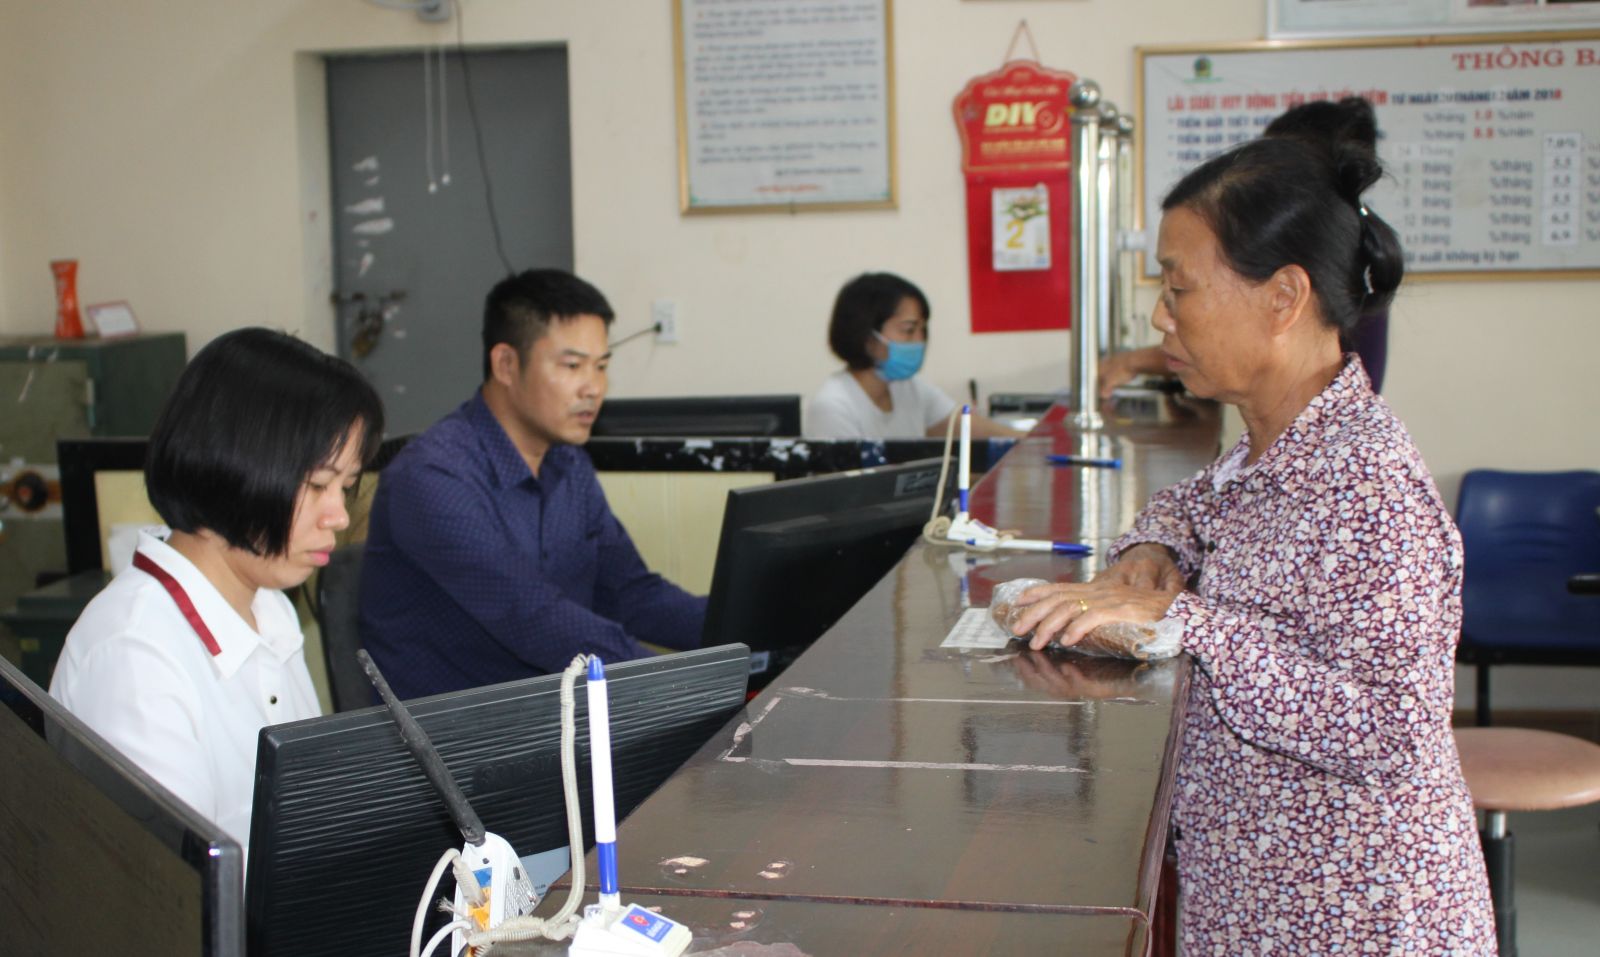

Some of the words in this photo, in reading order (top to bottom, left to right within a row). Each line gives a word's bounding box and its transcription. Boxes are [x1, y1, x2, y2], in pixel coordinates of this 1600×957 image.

[1452, 46, 1565, 71] THÔNG
[1575, 47, 1600, 67] B
[984, 101, 1036, 127] DIY
[1007, 218, 1024, 249] 2
